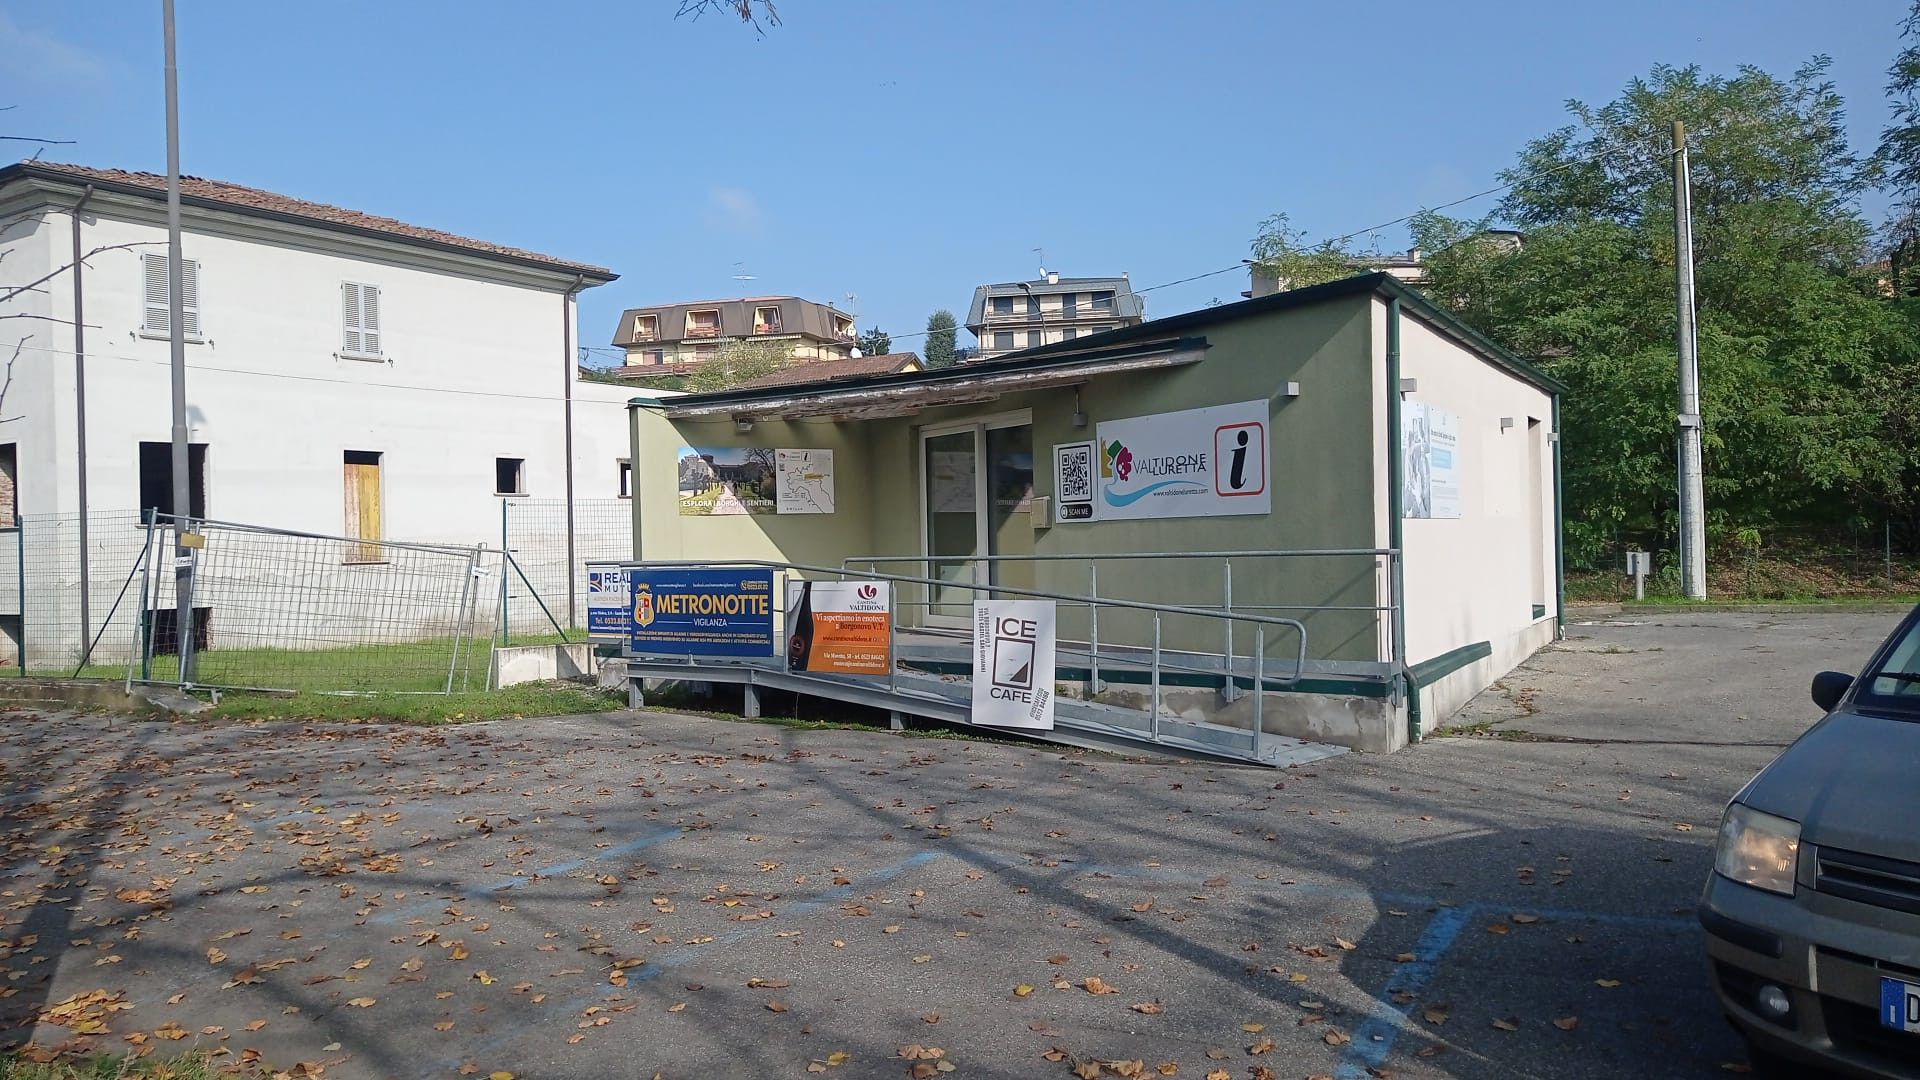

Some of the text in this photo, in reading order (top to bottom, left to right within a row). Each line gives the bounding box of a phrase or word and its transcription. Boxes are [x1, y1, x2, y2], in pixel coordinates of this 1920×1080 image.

[1153, 464, 1207, 476] LURETTA
[1068, 507, 1089, 516] SCAN ME
[604, 572, 632, 584] REAL
[656, 594, 769, 615] METRONOTTE
[693, 618, 728, 627] VIGILANZA
[816, 613, 823, 621] Vi
[823, 614, 855, 623] aspettiamo
[855, 613, 862, 621] in
[840, 622, 871, 631] Borgonovo
[872, 622, 885, 631] V.T.
[995, 616, 1038, 639] ICE
[990, 687, 1032, 704] CAFE
